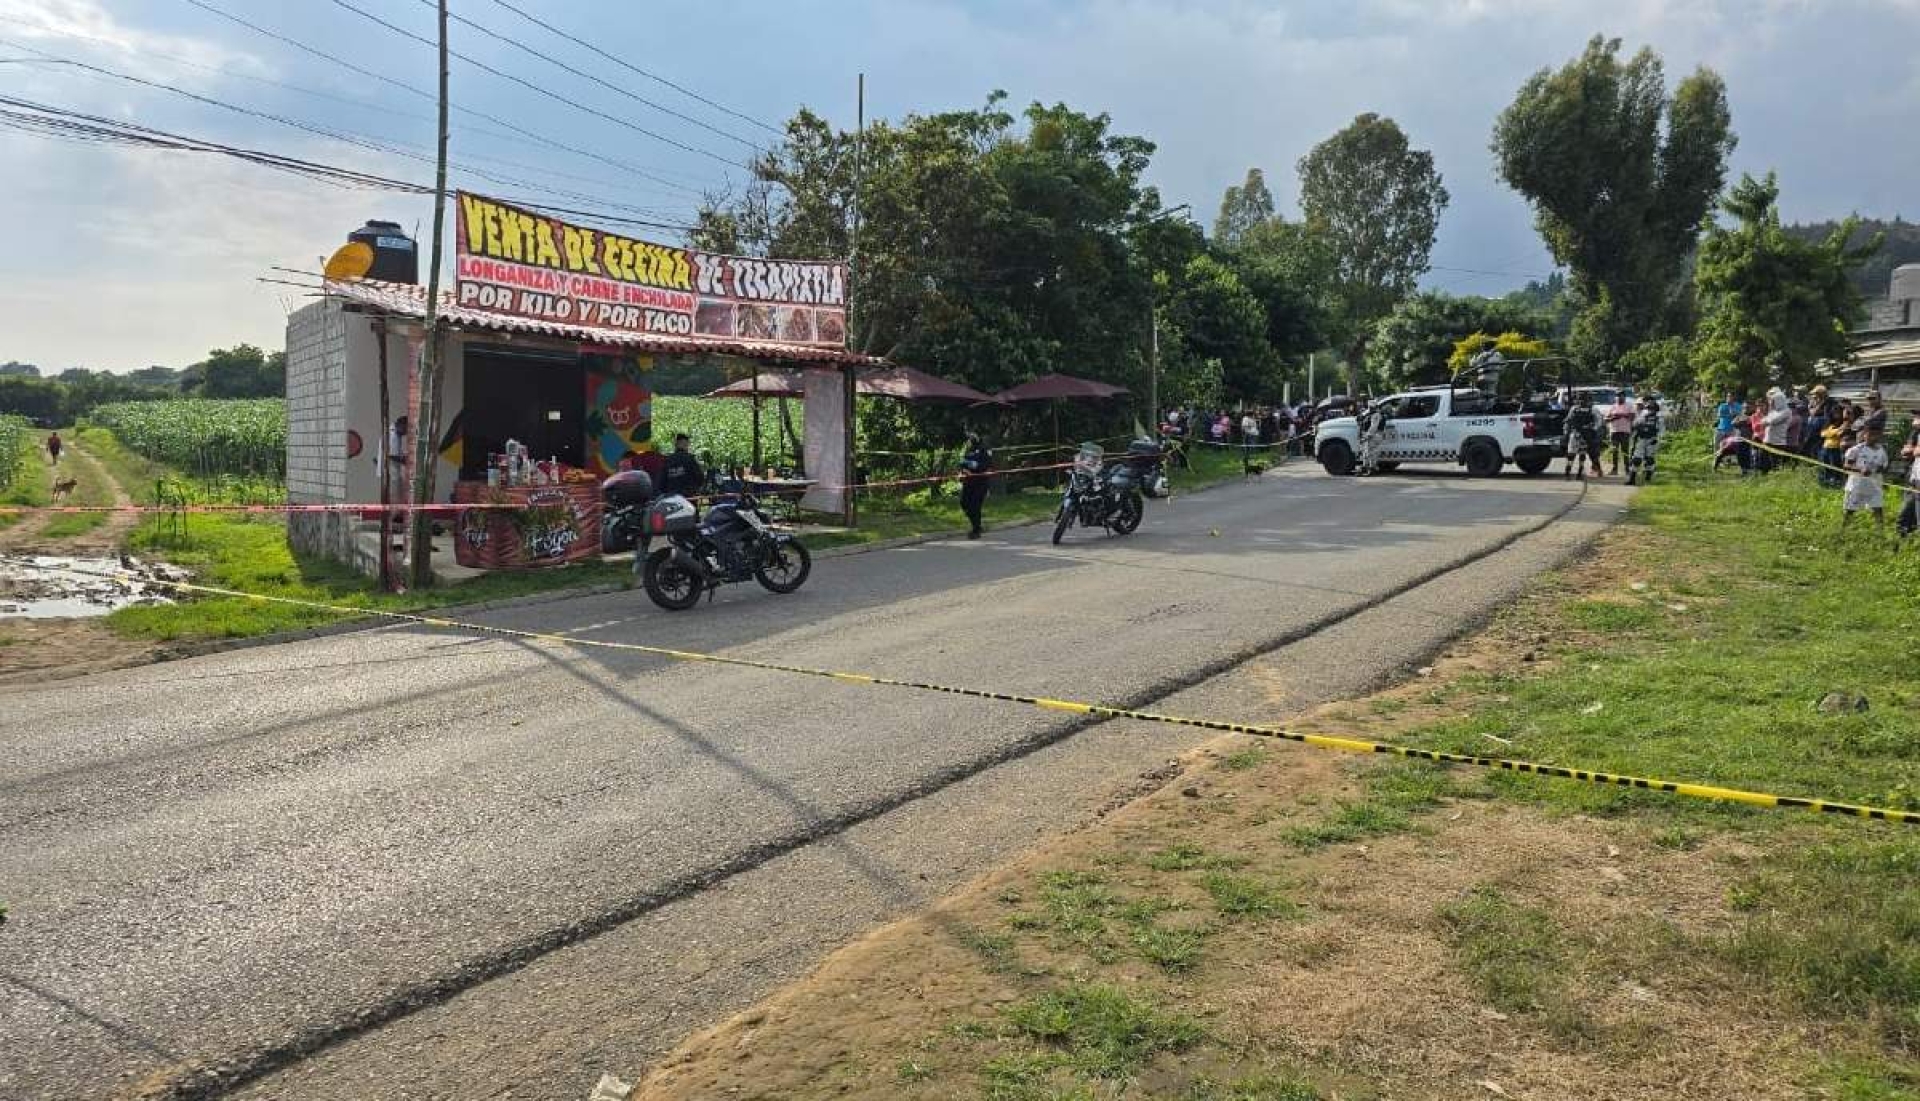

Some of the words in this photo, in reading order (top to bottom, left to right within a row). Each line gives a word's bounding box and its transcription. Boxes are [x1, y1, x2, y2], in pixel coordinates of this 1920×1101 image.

[462, 196, 561, 268] VENTA
[563, 226, 601, 275] DE
[603, 236, 692, 291] CECINA
[694, 254, 725, 295] DE
[460, 258, 555, 292] LONGANIZA
[557, 272, 569, 295] Y
[571, 277, 620, 301] CARNE
[624, 284, 693, 311] ENCHILADA
[460, 282, 513, 309] POR
[519, 292, 572, 318] KILO
[578, 300, 592, 321] Y
[597, 303, 640, 328] POR
[644, 309, 691, 333] TACO
